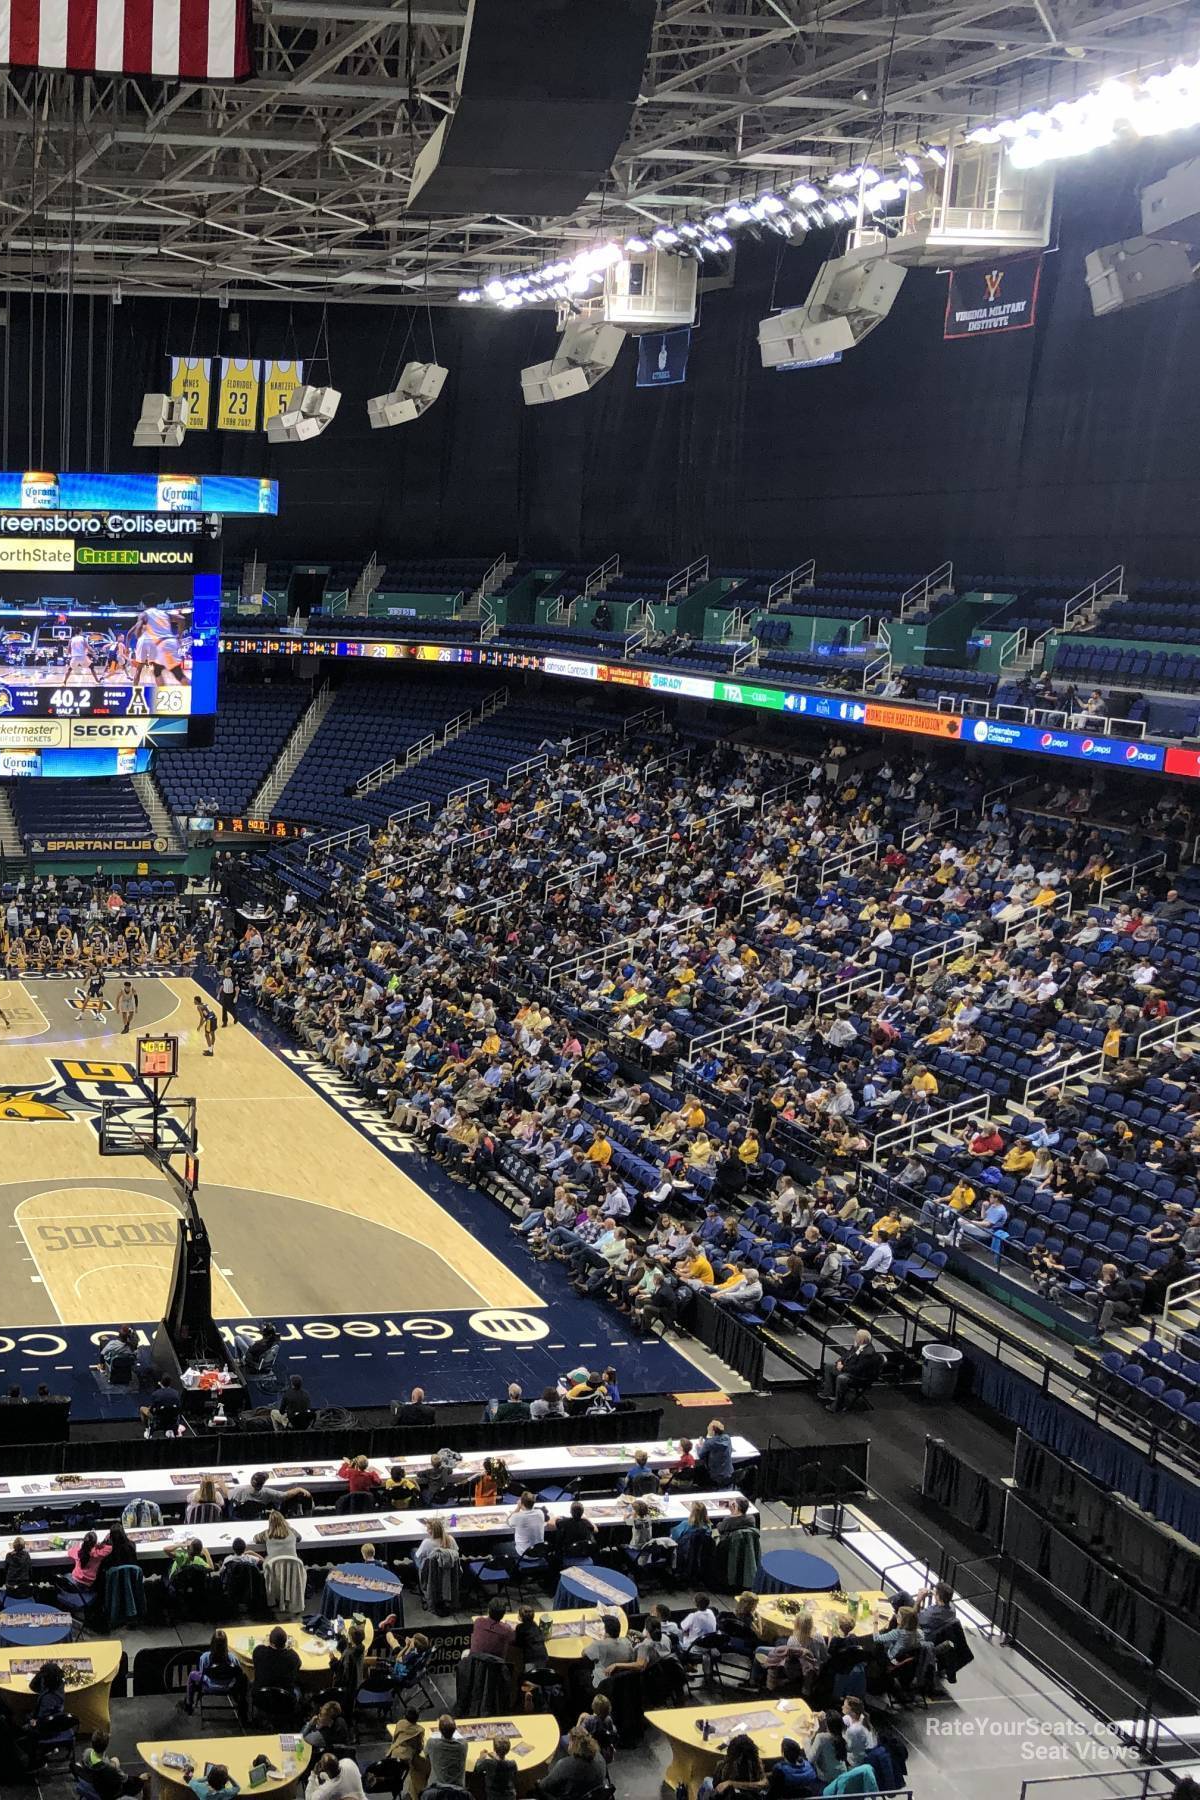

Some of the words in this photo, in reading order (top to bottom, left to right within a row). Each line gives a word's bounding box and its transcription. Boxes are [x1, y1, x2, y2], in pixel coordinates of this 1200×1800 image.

[955, 308, 987, 322] VIRGINIA
[989, 301, 1027, 317] MILITARY
[968, 315, 1009, 332] INSTITUTE
[226, 380, 253, 390] ELDRIDGE
[228, 392, 249, 415] 23
[278, 394, 288, 414] 5
[24, 485, 57, 499] Corona
[162, 486, 199, 501] Corona
[170, 501, 192, 511] Extra
[107, 514, 197, 533] Coliseum
[77, 547, 139, 564] GREEN
[140, 552, 193, 564] LINCOLN
[226, 642, 232, 650] 2
[247, 642, 256, 650] 11
[270, 643, 279, 651] 13
[373, 646, 387, 658] 29
[439, 650, 451, 661] 26
[545, 661, 566, 673] Johnson
[567, 663, 589, 676] Controls
[658, 676, 682, 689] BRADY
[50, 689, 91, 708] 40.2
[156, 690, 183, 712] 26
[882, 710, 894, 724] HIGH
[73, 725, 137, 736] SEGRA
[988, 725, 1021, 738] Greensboro
[23, 735, 51, 743] TICKETS
[988, 732, 1013, 744] Coliseum
[1051, 739, 1069, 748] pepsi
[1093, 745, 1111, 755] pepsi
[1137, 751, 1157, 761] pepsi
[3, 756, 38, 769] Corona
[276, 828, 286, 836] 26
[47, 840, 113, 851] SPARTAN
[114, 840, 152, 851] CLUB
[37, 1221, 178, 1251] SOCON
